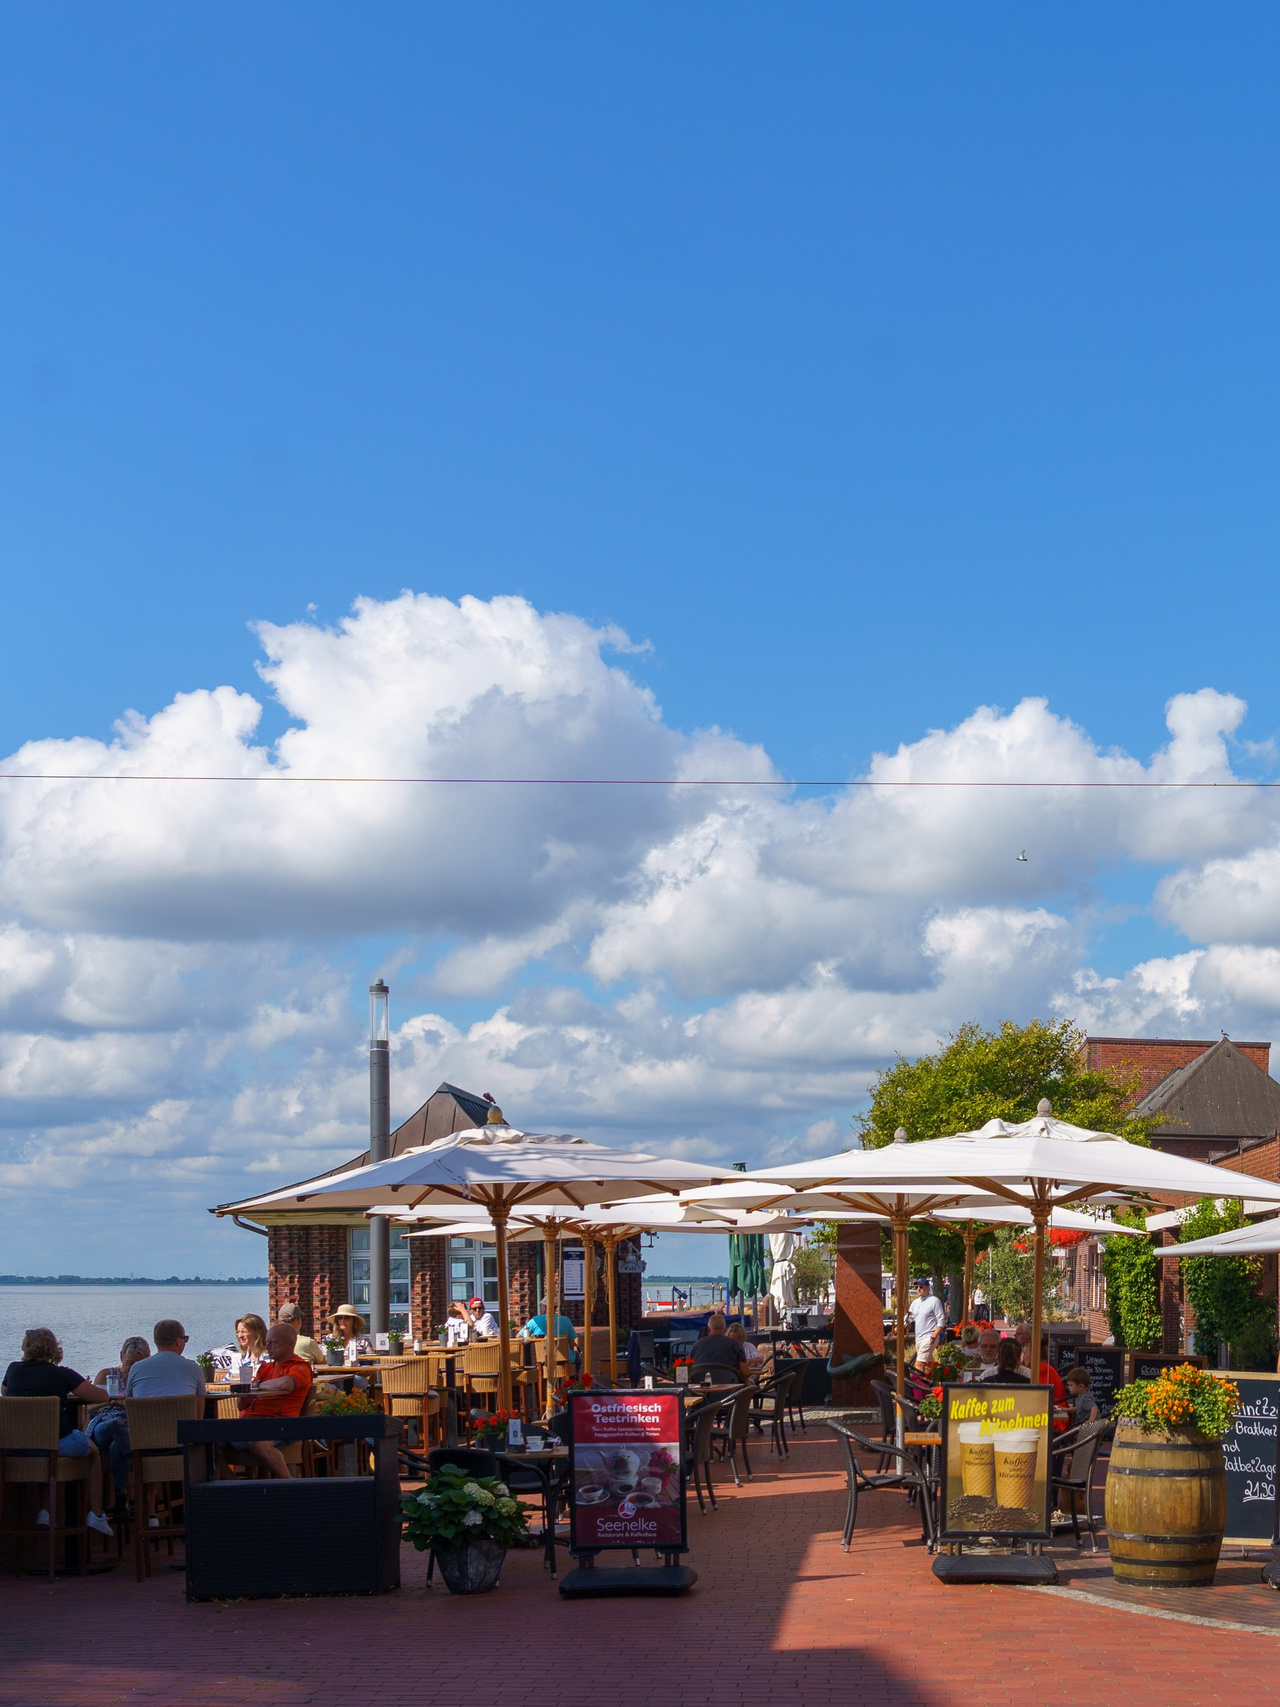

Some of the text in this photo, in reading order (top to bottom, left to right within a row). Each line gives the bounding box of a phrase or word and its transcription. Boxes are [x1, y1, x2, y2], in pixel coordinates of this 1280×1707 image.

[591, 1403, 662, 1413] Ostfriesisch
[950, 1397, 1015, 1420] Kaffee zum
[593, 1414, 660, 1423] Teetrinken
[979, 1412, 1049, 1437] Mitnehmen
[1222, 1440, 1240, 1452] nd
[1003, 1457, 1028, 1467] Kaffee
[1244, 1480, 1276, 1498] 21,90
[596, 1518, 657, 1531] Seenelke
